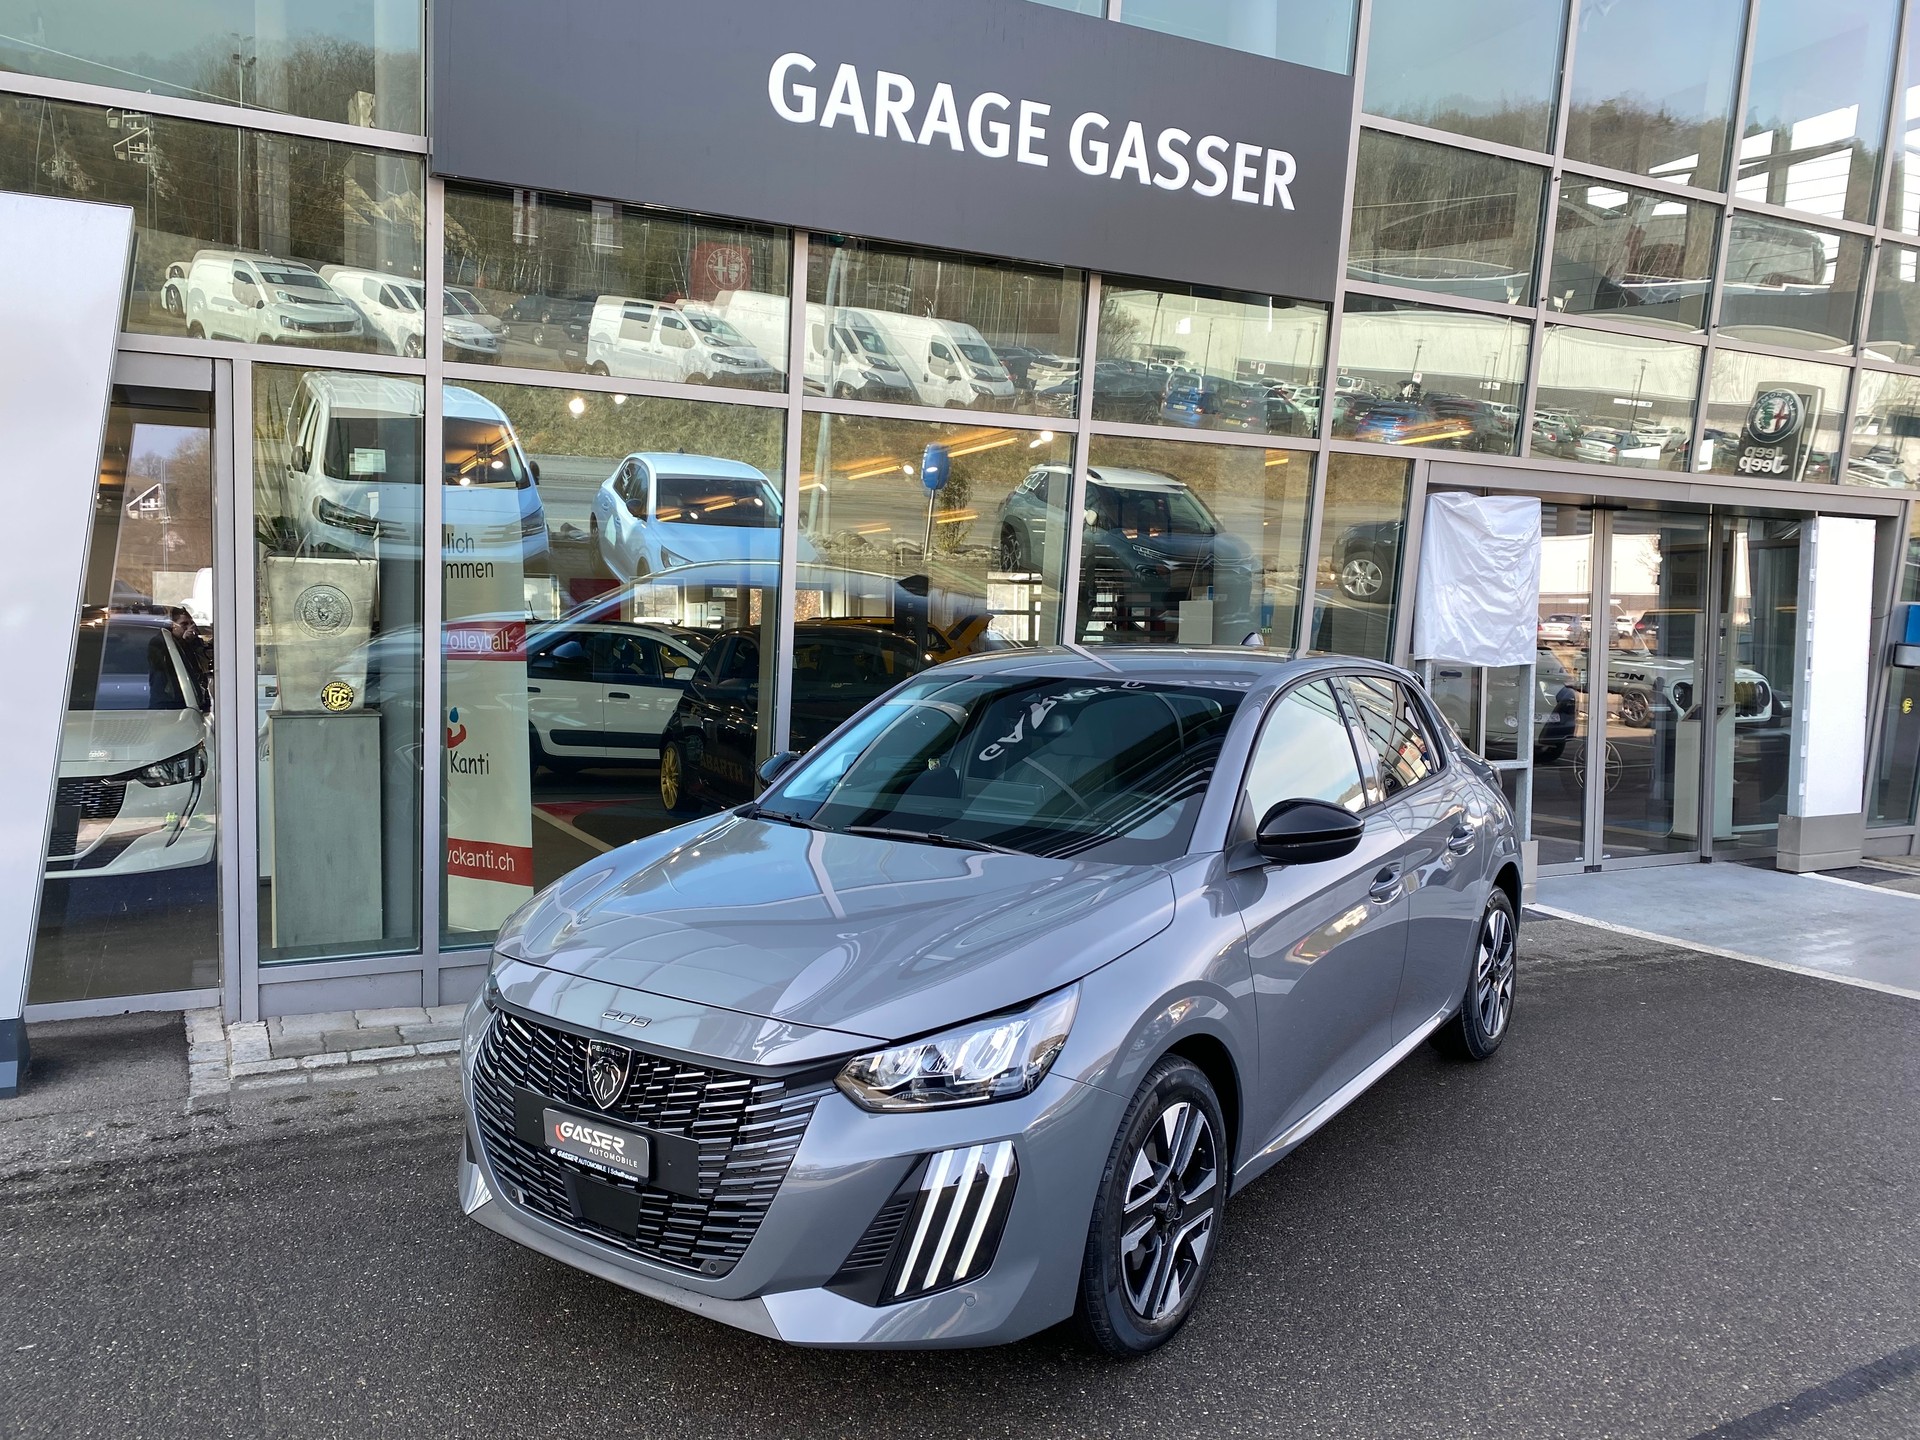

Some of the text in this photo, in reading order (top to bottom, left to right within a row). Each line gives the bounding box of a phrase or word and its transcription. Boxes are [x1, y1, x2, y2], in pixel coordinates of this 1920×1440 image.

[768, 52, 1297, 211] GARAGE GASSER
[450, 750, 490, 775] Kanti
[601, 1009, 652, 1028] 208
[591, 1044, 627, 1059] PEUGEOT
[560, 1121, 625, 1155] GASSER
[578, 1157, 607, 1173] AUTOMOBILE
[588, 1146, 638, 1169] AUTOMOBILE
